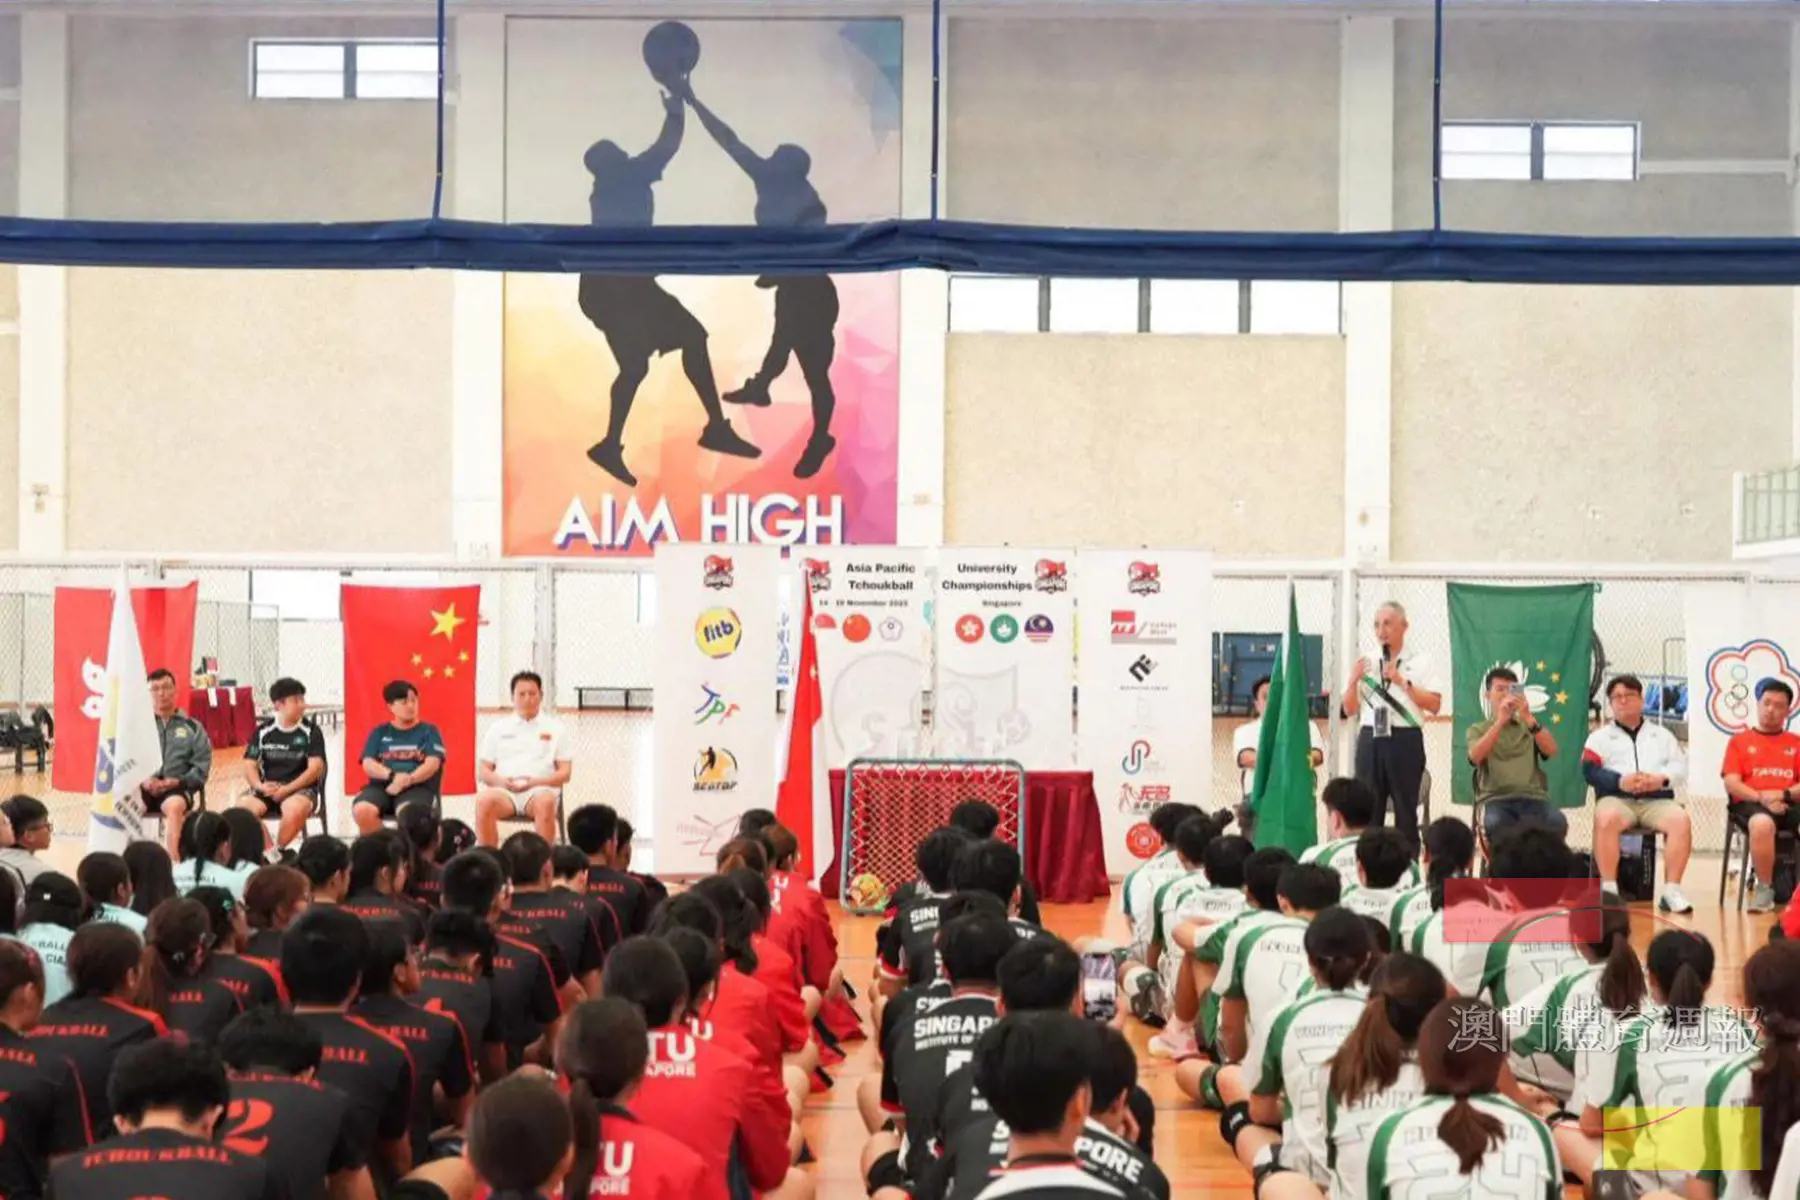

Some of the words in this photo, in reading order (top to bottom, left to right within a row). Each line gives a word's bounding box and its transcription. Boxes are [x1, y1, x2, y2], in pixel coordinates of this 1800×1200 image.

[552, 493, 683, 549] AIM
[700, 492, 845, 547] HIGH
[846, 562, 873, 574] Asia
[875, 562, 917, 574] Pacific
[957, 562, 1018, 575] University
[847, 579, 914, 591] Tchoukball
[941, 579, 1033, 592] Championships
[703, 619, 735, 644] fitb
[914, 1015, 1000, 1038] SINGAP
[647, 1032, 697, 1063] TU
[644, 1062, 697, 1078] APORE
